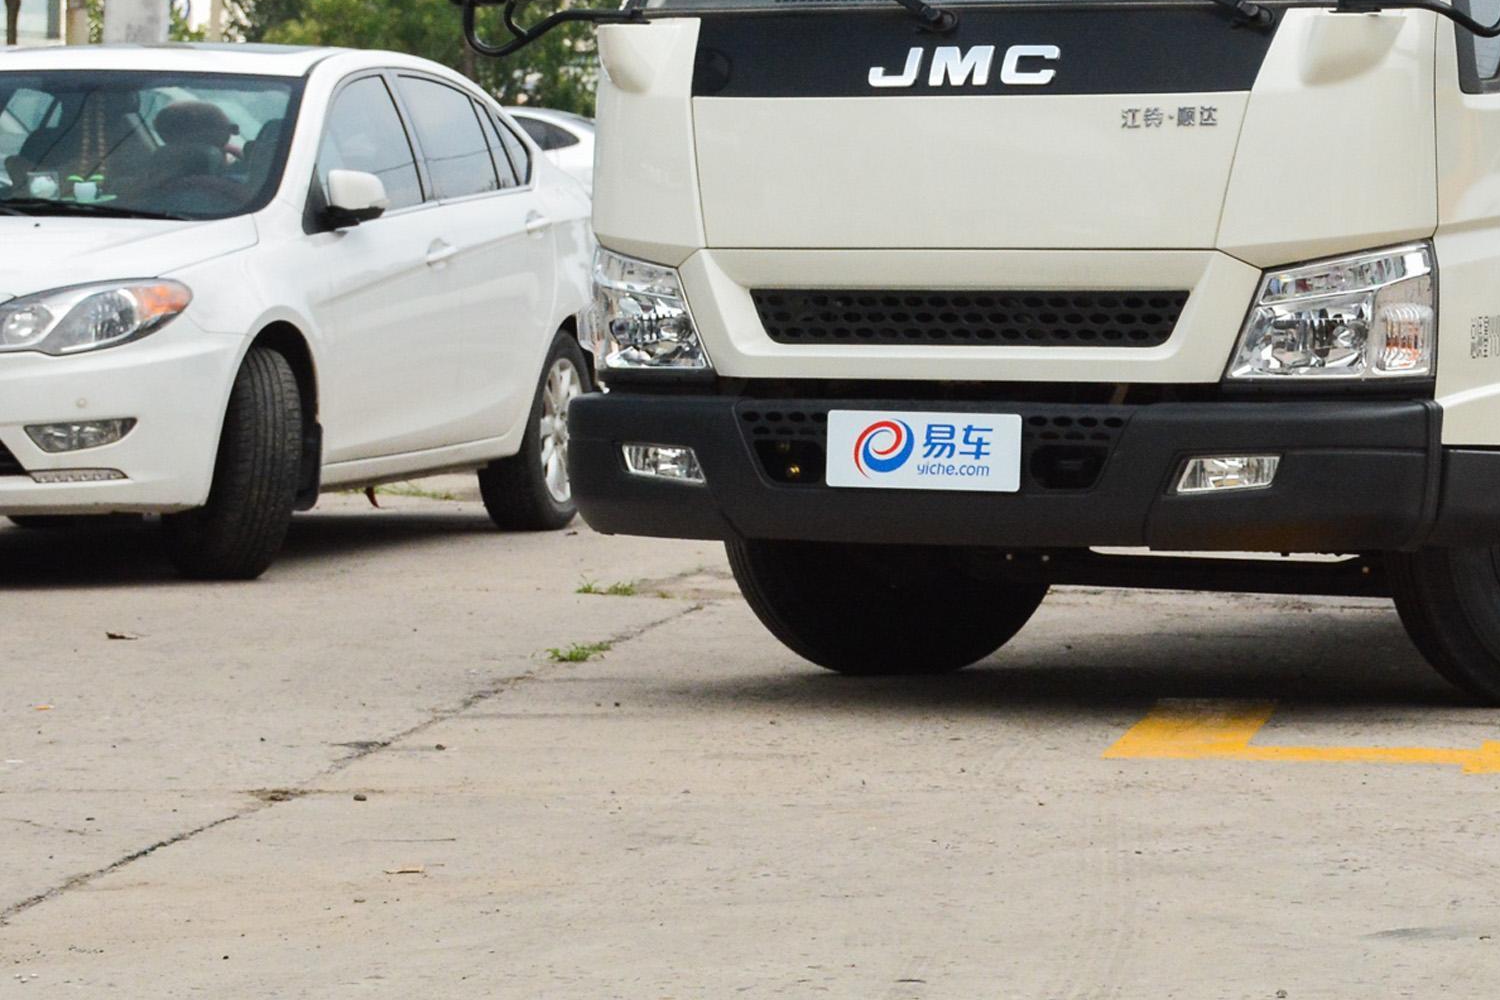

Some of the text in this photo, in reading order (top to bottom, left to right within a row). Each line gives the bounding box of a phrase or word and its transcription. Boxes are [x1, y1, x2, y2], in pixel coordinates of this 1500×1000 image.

[868, 45, 1061, 87] JMC
[923, 424, 994, 460] 易车
[917, 463, 990, 477] yiche.com
